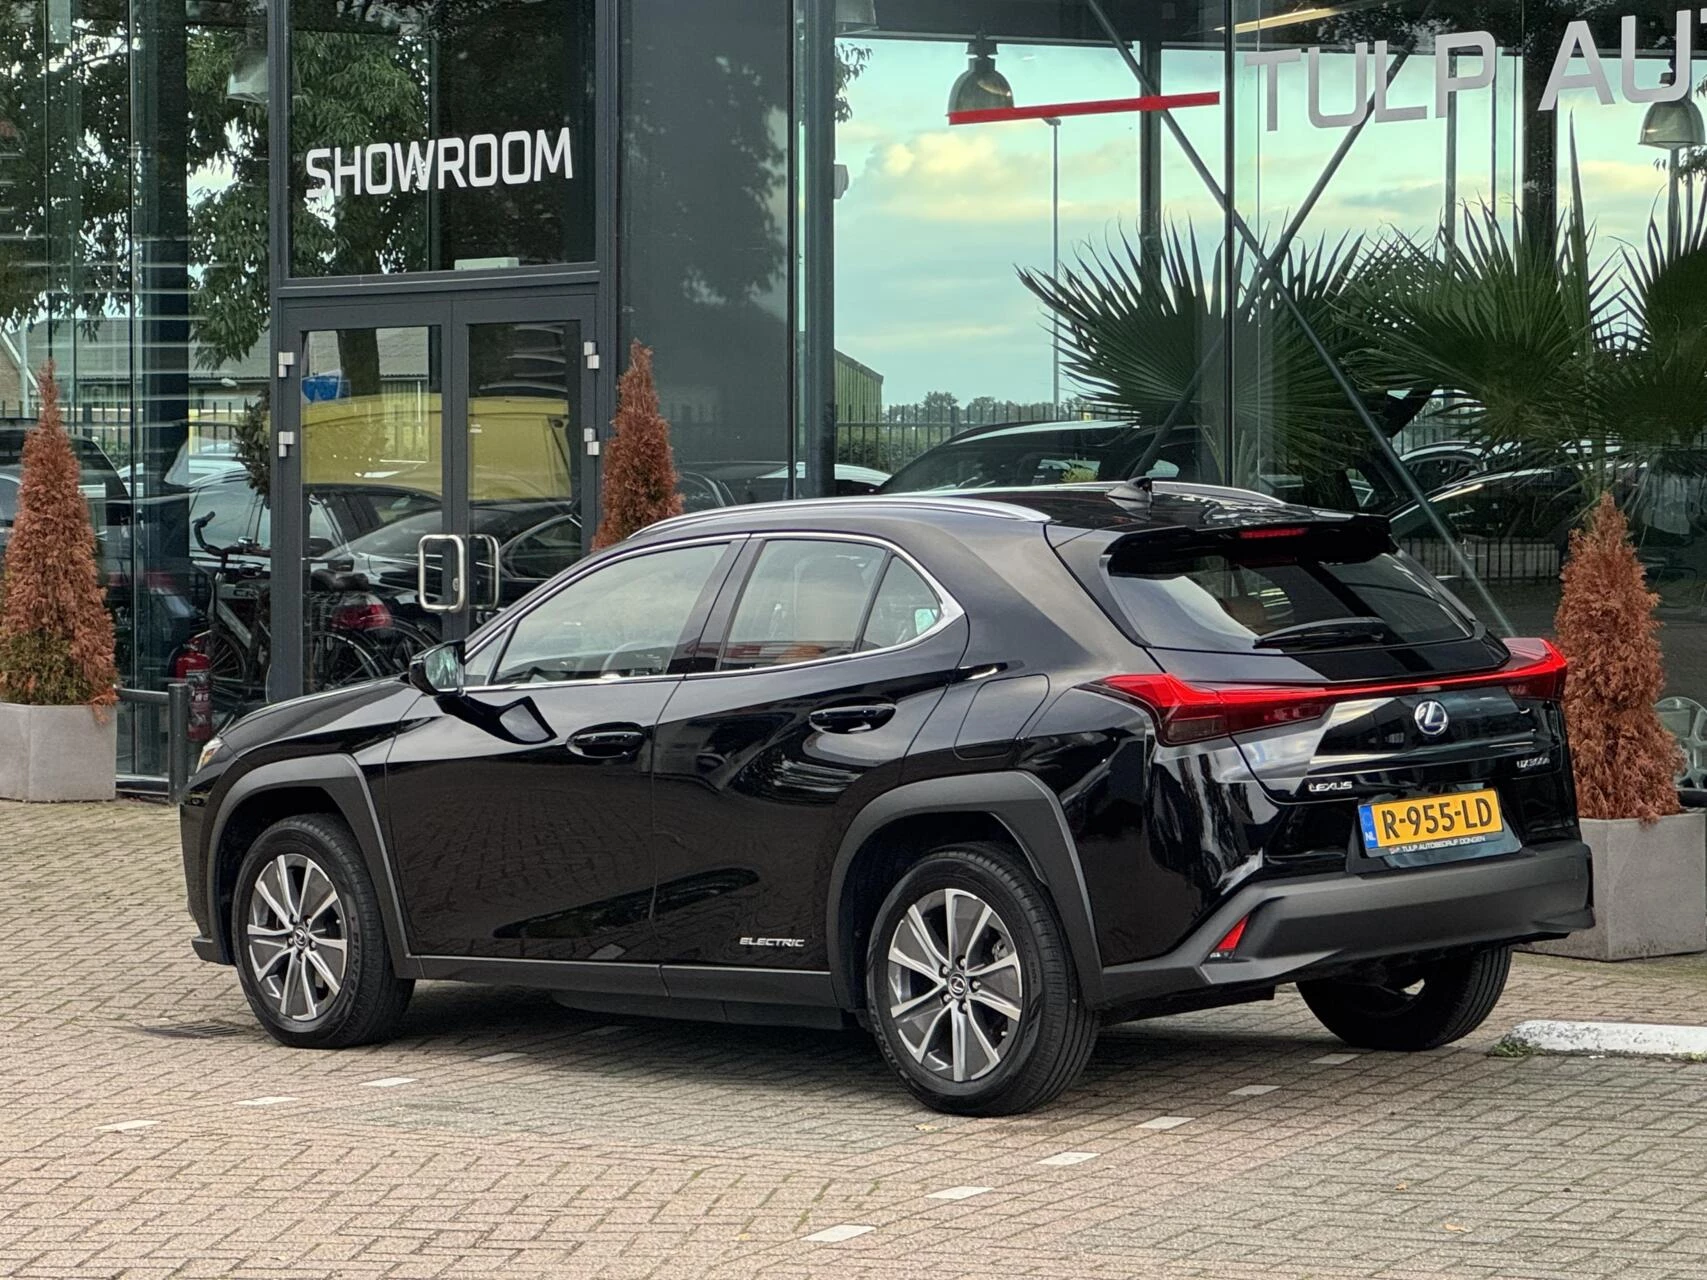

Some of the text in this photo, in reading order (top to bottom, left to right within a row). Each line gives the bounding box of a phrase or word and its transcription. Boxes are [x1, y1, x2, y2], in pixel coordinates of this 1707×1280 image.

[1244, 7, 1707, 132] TULP AU
[306, 126, 574, 198] SHOWROOM
[1308, 780, 1353, 793] LEXUS
[1381, 797, 1493, 840] R-955-LD
[1364, 832, 1377, 841] NL
[739, 936, 806, 947] ELECTRIC
